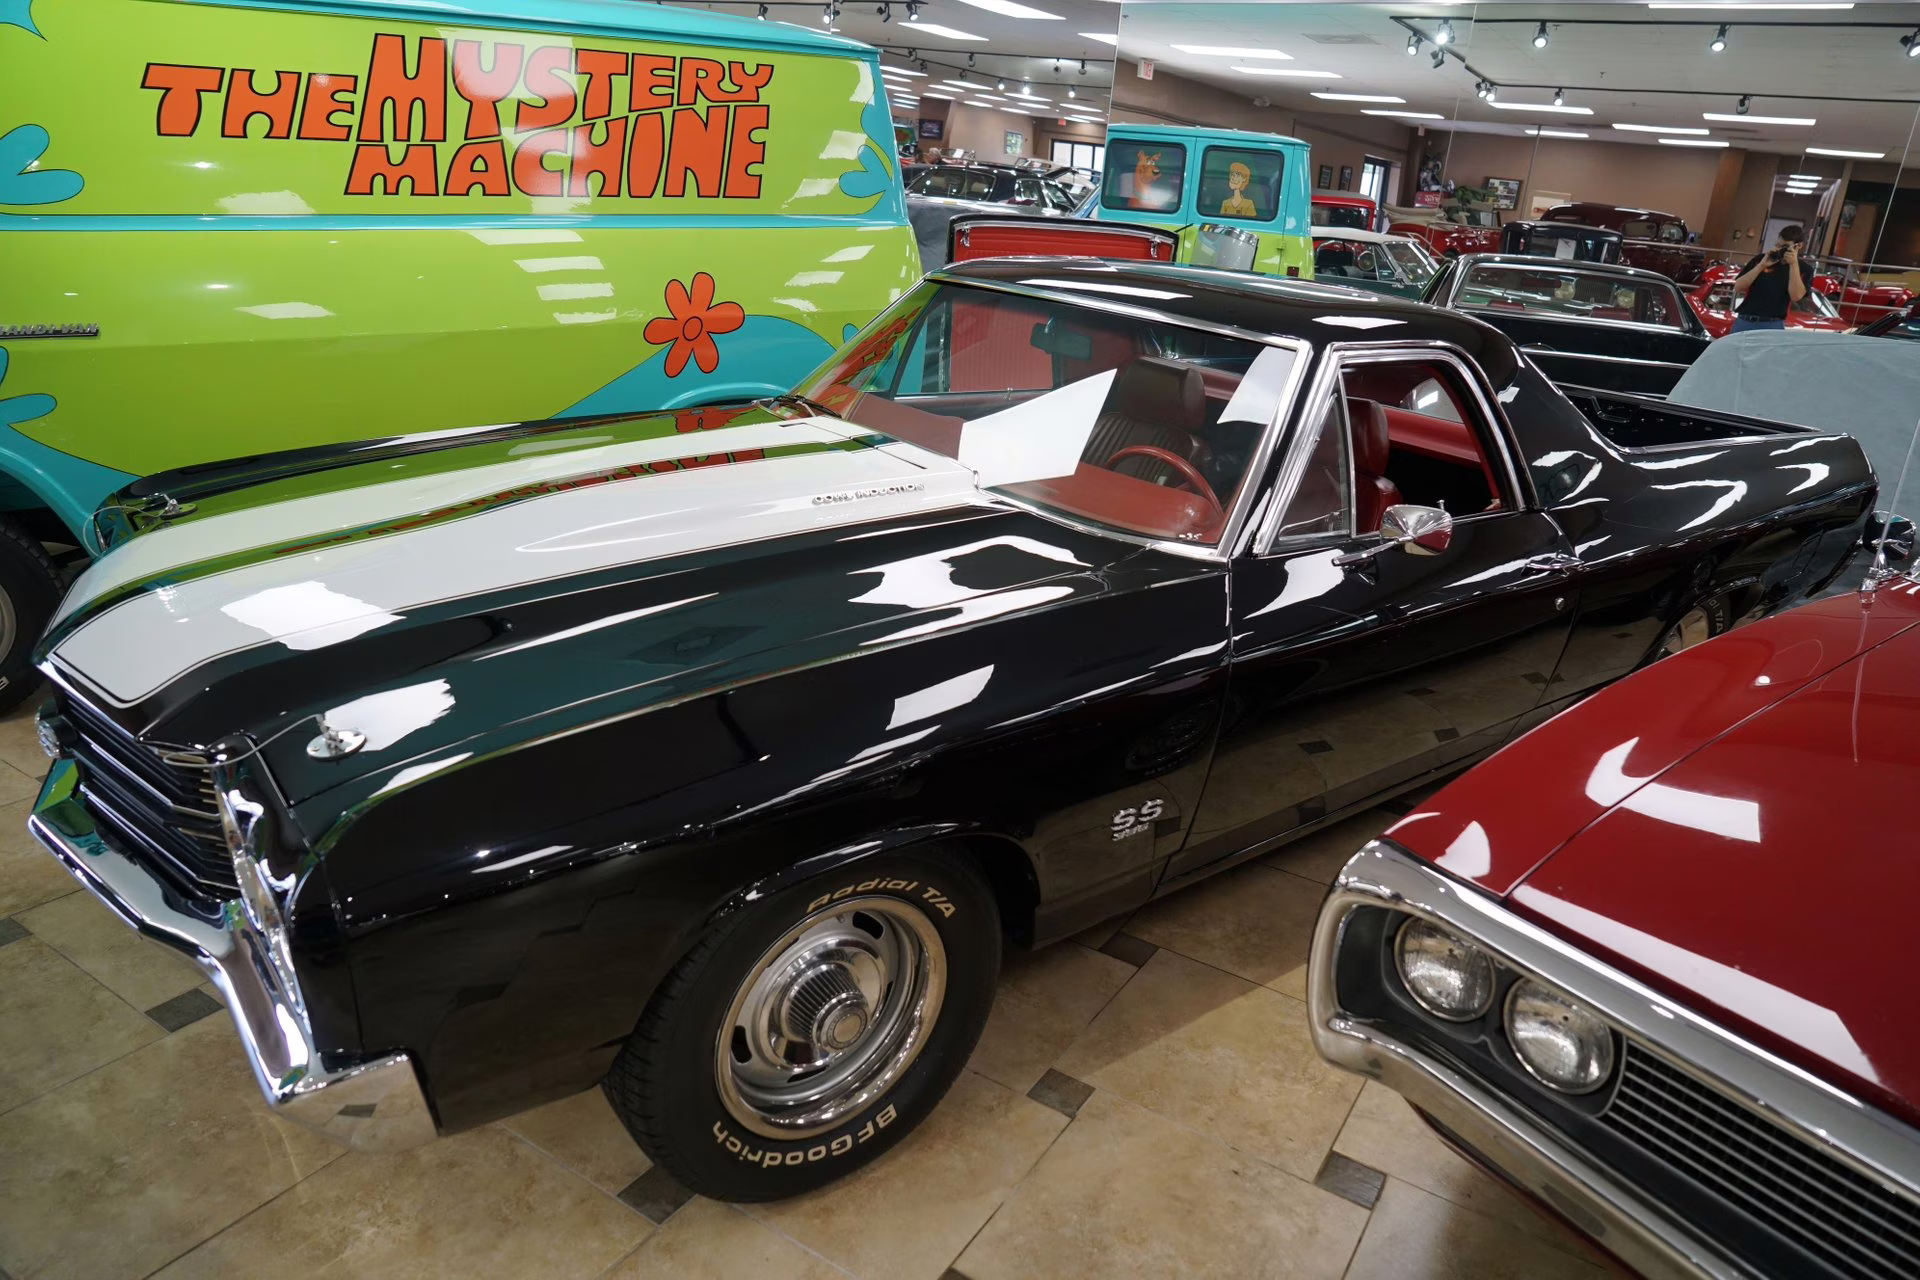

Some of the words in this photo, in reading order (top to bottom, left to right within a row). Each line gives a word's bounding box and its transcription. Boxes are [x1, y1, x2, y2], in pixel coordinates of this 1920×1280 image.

[140, 62, 357, 141] THE
[358, 33, 774, 142] MYSTERY
[344, 105, 770, 199] MACHINE
[1111, 799, 1164, 831] SS
[922, 886, 957, 918] T/A
